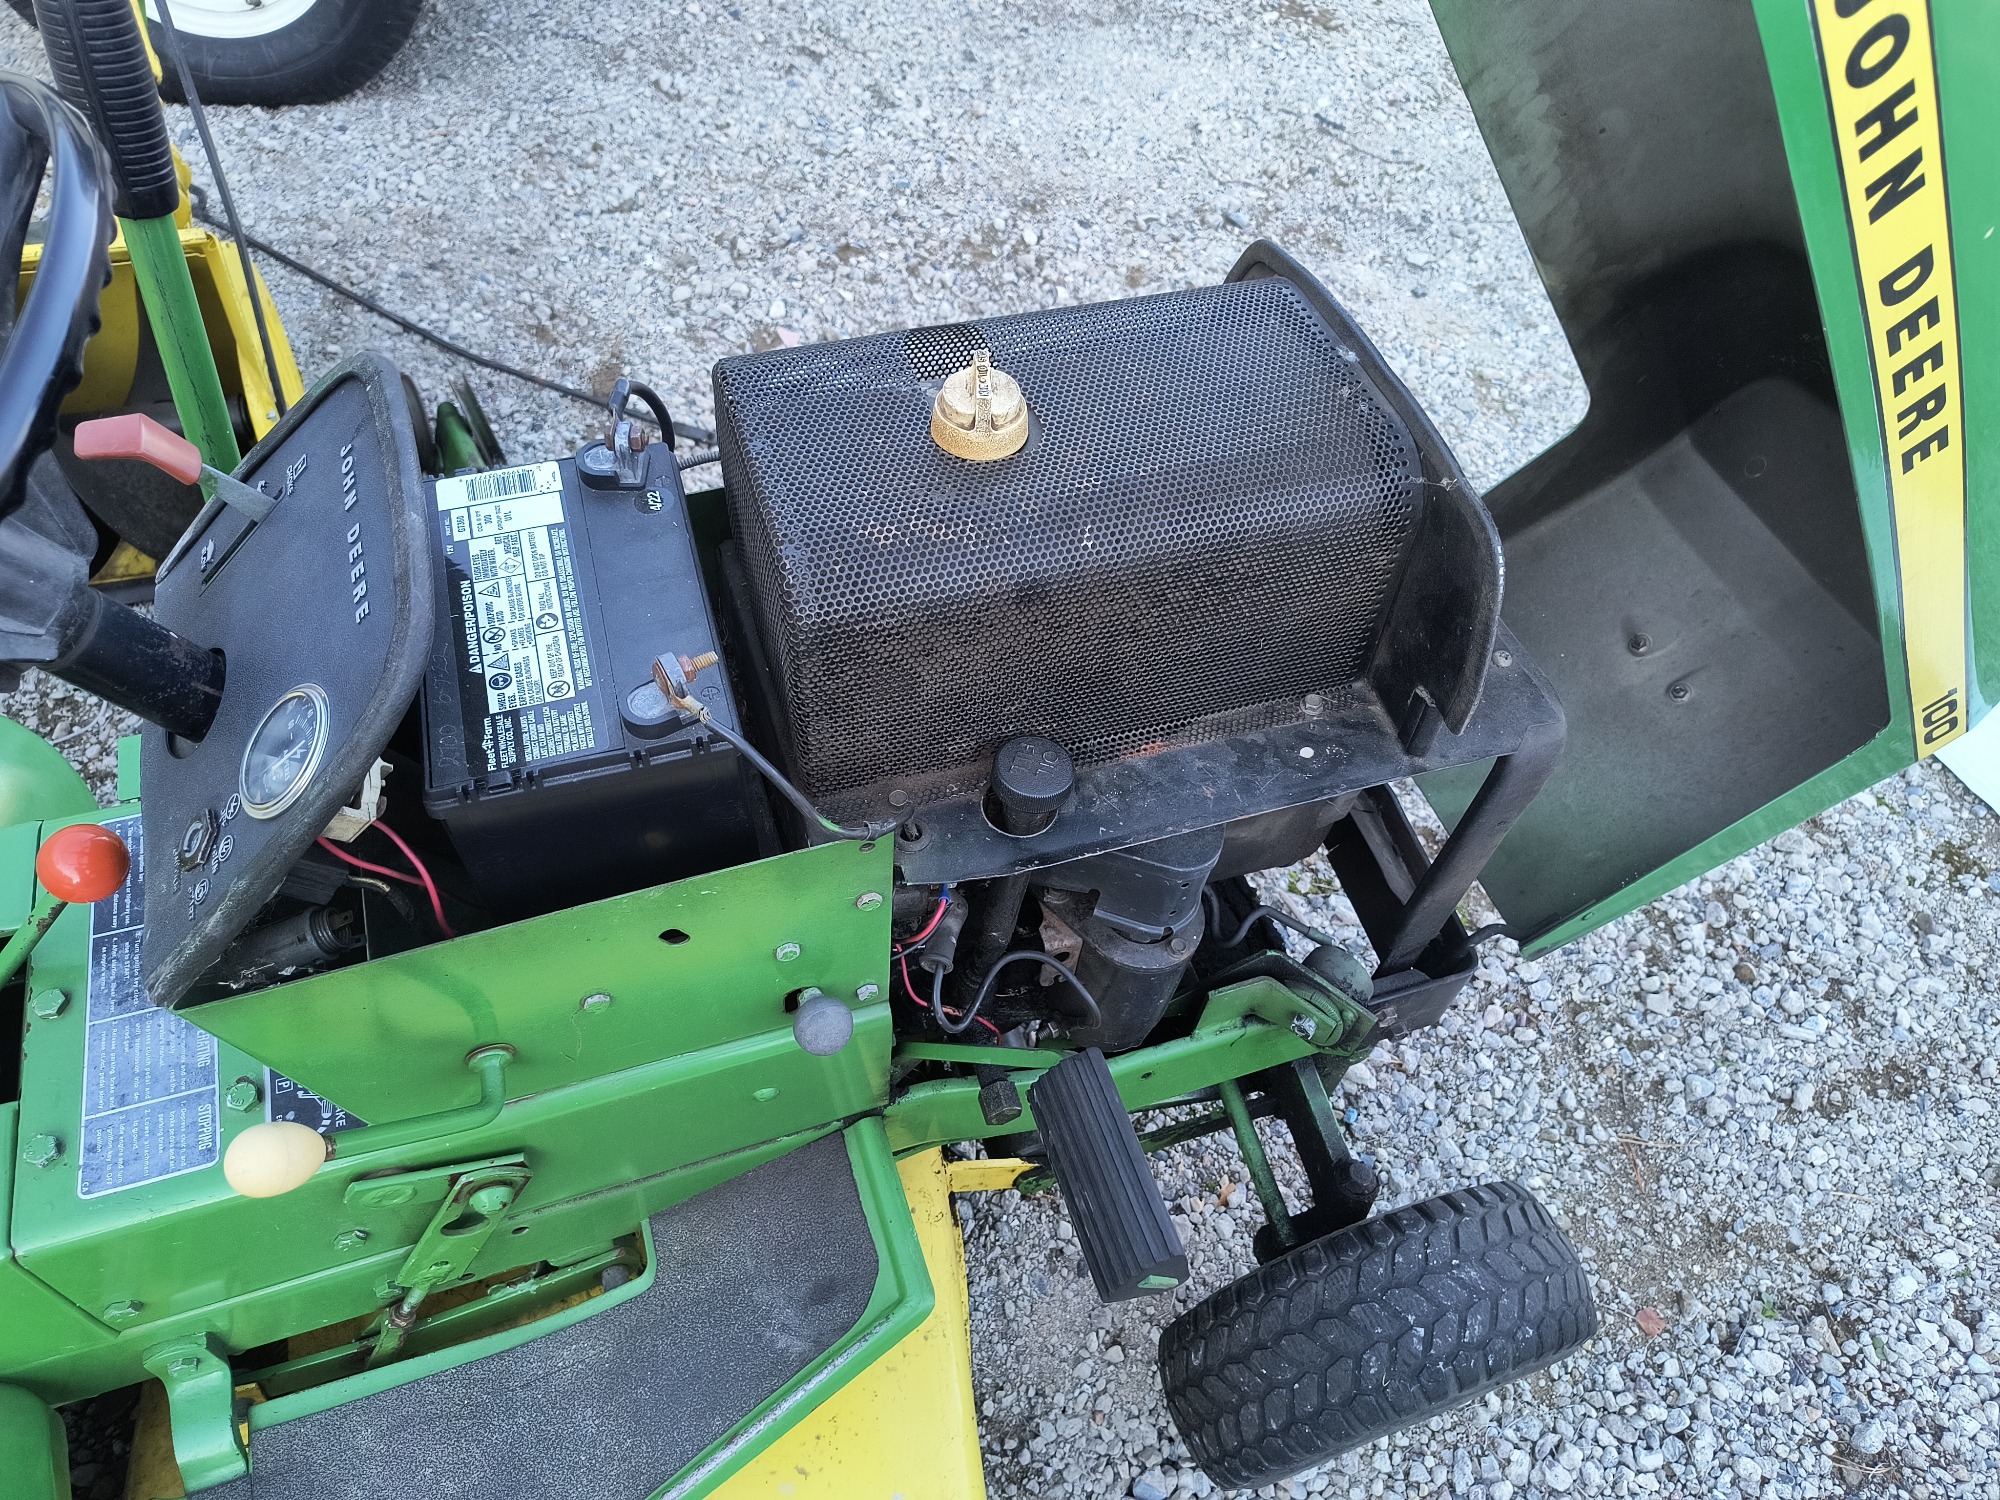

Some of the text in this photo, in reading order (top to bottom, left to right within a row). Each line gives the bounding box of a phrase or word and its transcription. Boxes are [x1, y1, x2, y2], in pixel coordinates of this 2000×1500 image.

[1878, 243, 1949, 475] DEERE
[340, 444, 368, 622] JOHN DEERE
[493, 536, 502, 544] GET
[502, 534, 511, 554] MEDICAL
[527, 531, 536, 549] BATTERY
[509, 532, 520, 557] HELP FAST.
[530, 549, 538, 561] OPEN
[471, 553, 482, 580] FLUSH EYES
[479, 549, 489, 579] IMMEDIATELY
[487, 548, 498, 577] WITH WATER.
[485, 601, 495, 624] SULFURIC
[507, 598, 516, 611] CAUSE
[460, 580, 479, 662] DANGER/POISON
[495, 610, 504, 622] ACID
[493, 643, 501, 651] NO
[522, 655, 532, 679] BLINDNESS
[513, 661, 527, 706] EXPLOSIVE GASES
[525, 679, 534, 694] CAUSE
[496, 692, 506, 710] SHIELD
[507, 692, 517, 708] EYES.
[1922, 687, 1958, 745] 100
[495, 714, 509, 768] FLEET WHOLESALE
[506, 741, 516, 763] SUPPLY
[485, 748, 496, 771] Fleet
[132, 953, 140, 975] ignition
[132, 976, 140, 987] key
[108, 1052, 116, 1074] parking
[278, 1080, 290, 1088] P
[156, 1113, 164, 1136] parking
[197, 1103, 212, 1149] STOPPING
[106, 1128, 114, 1148] ignition
[105, 1150, 113, 1161] key
[81, 1181, 89, 1192] CA
